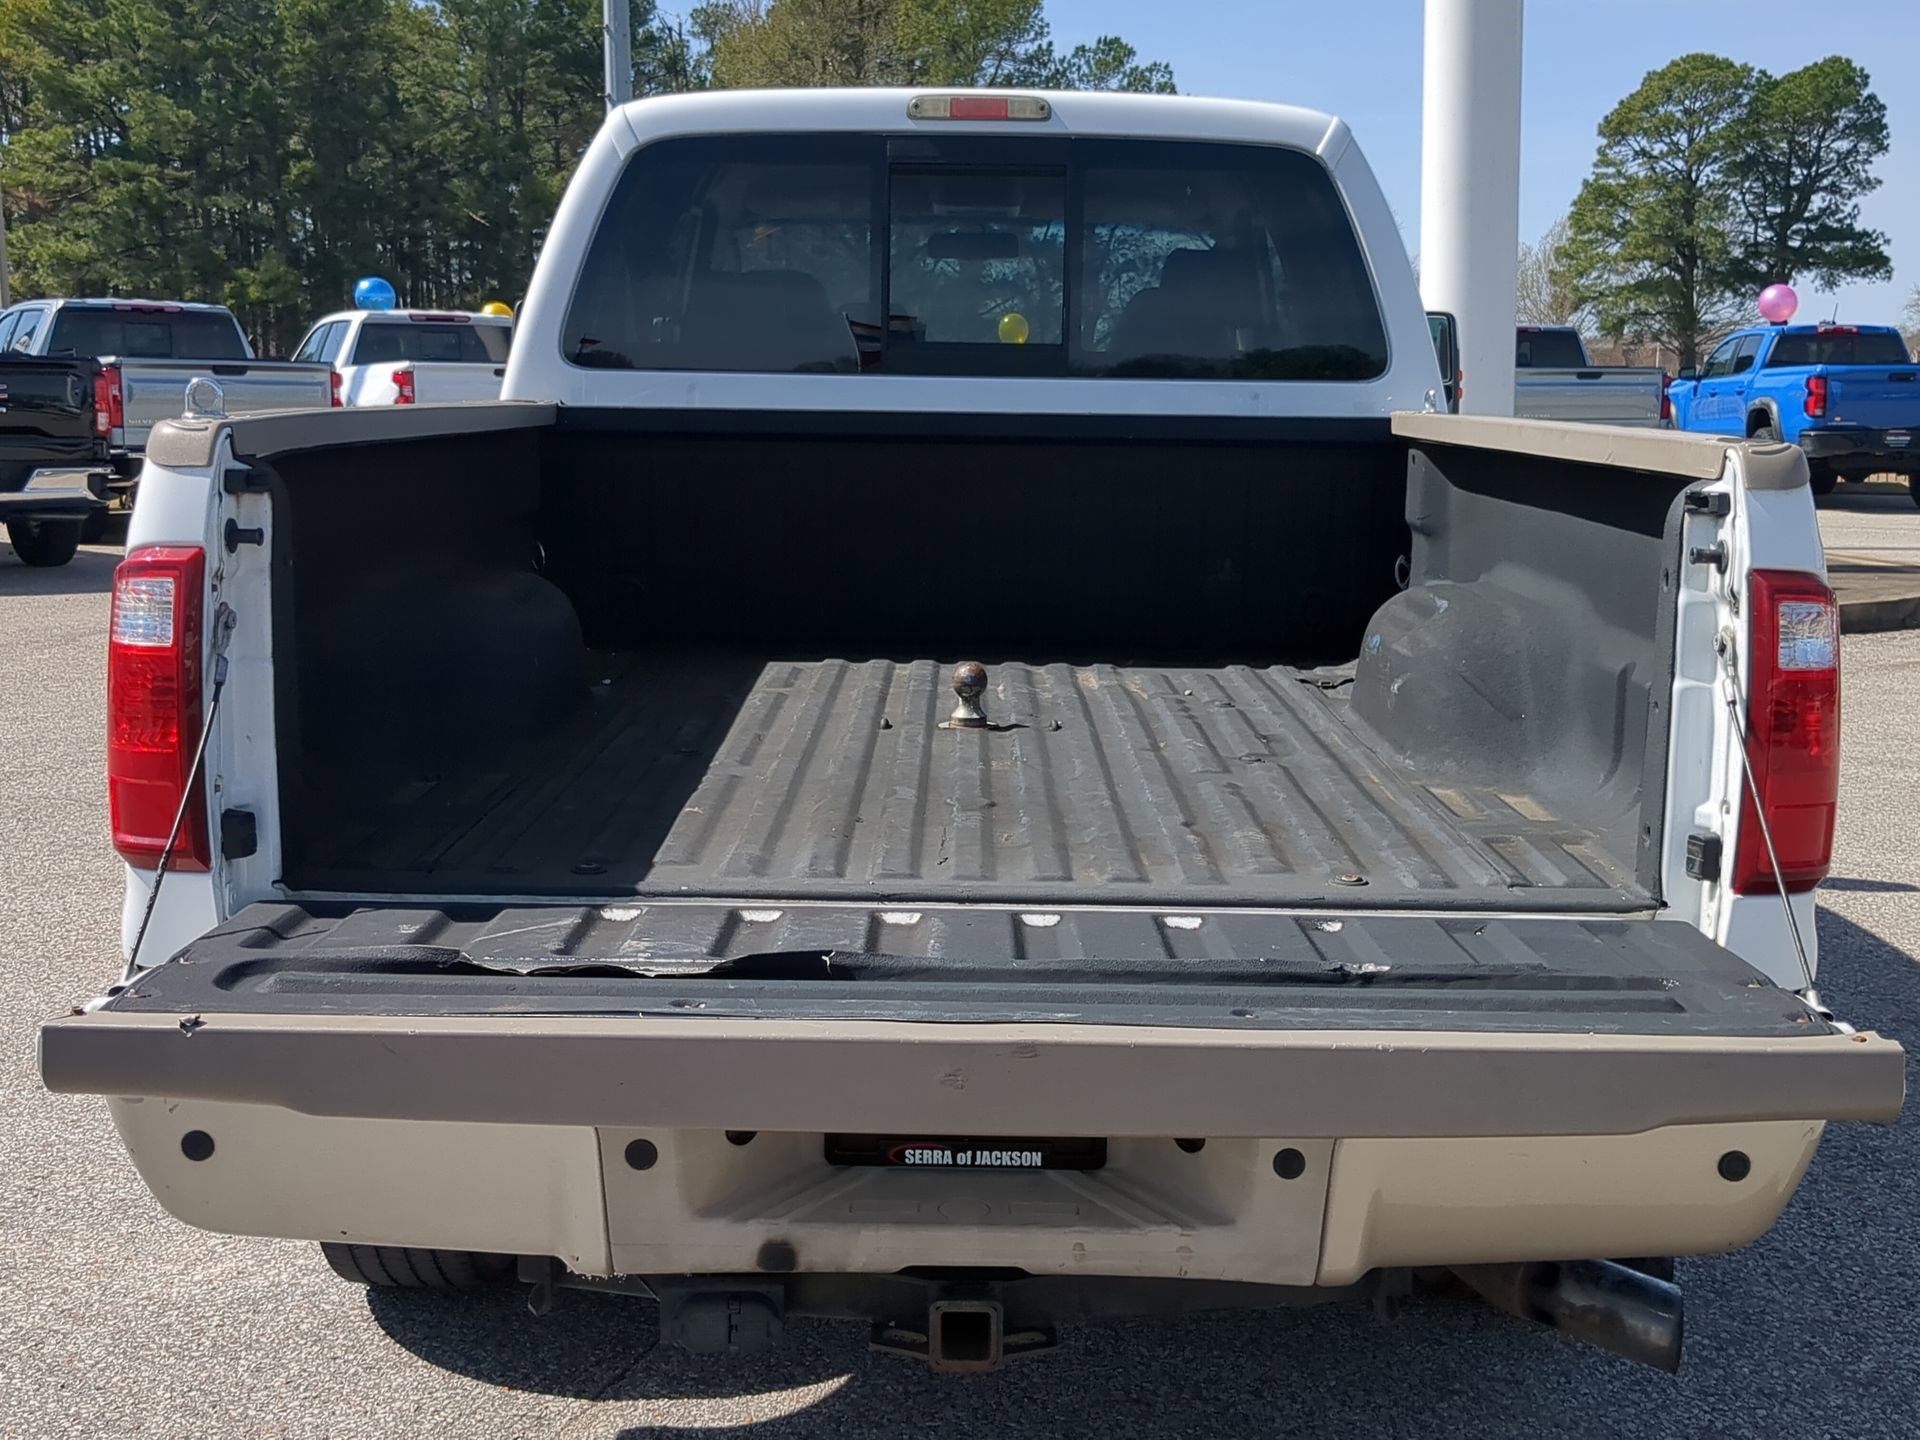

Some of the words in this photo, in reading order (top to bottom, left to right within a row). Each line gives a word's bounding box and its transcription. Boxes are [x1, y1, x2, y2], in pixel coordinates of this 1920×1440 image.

[905, 1149, 954, 1165] SERRA
[957, 1150, 974, 1165] of
[975, 1151, 1043, 1166] JACKSON
